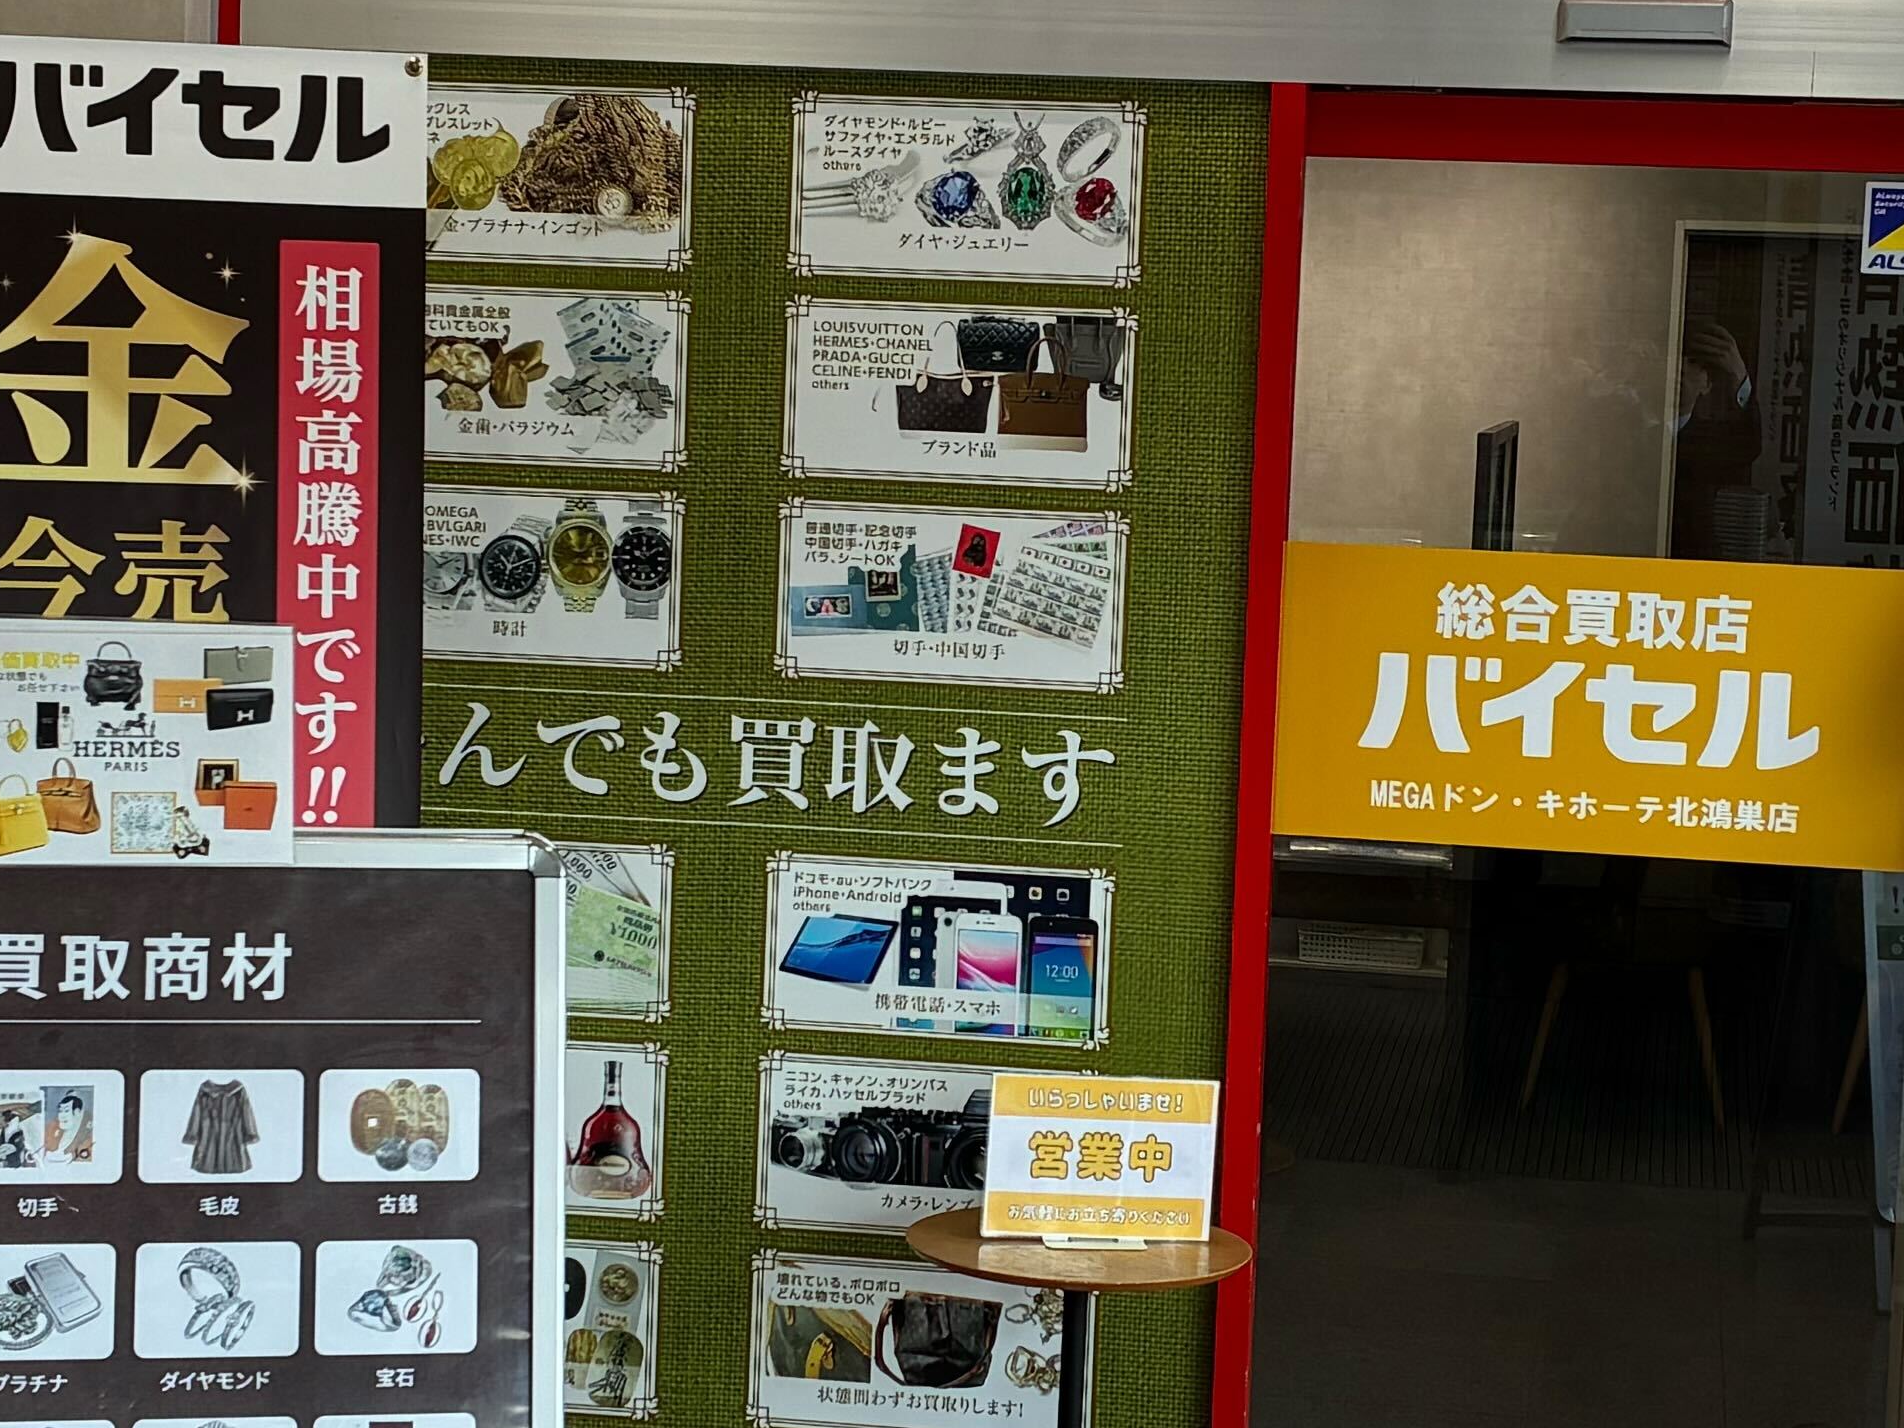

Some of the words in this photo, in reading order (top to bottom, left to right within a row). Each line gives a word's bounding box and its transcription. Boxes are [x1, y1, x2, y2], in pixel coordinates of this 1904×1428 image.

[824, 116, 946, 130] ダイヤモンド・ルビー
[823, 146, 901, 159] ルースダイヤ
[446, 217, 602, 236] 金・プラチナ・インゴット
[898, 233, 1029, 252] ダイヤ・ジュエリー
[922, 439, 997, 459] ブランド品
[1435, 581, 1752, 654] 総合買取店
[493, 620, 526, 637] 時計
[893, 639, 1006, 660] 切手・中国切手
[1358, 652, 1820, 770] バイセル
[104, 762, 148, 772] PARIS
[439, 702, 1115, 826] んでも買取ます
[1370, 780, 1799, 834] MEGAドン・キホーテ北鴻巣店
[876, 993, 1001, 1015] 携帯電話・スマホ
[1029, 1088, 1185, 1113] いらっしゃいませ!
[1027, 1130, 1174, 1183] 営業中
[17, 1196, 59, 1218] 切手
[198, 1195, 239, 1217] 毛皮
[377, 1194, 417, 1215] 古銭
[159, 1370, 270, 1392] ダイヤモンド
[375, 1368, 414, 1389] 宝石
